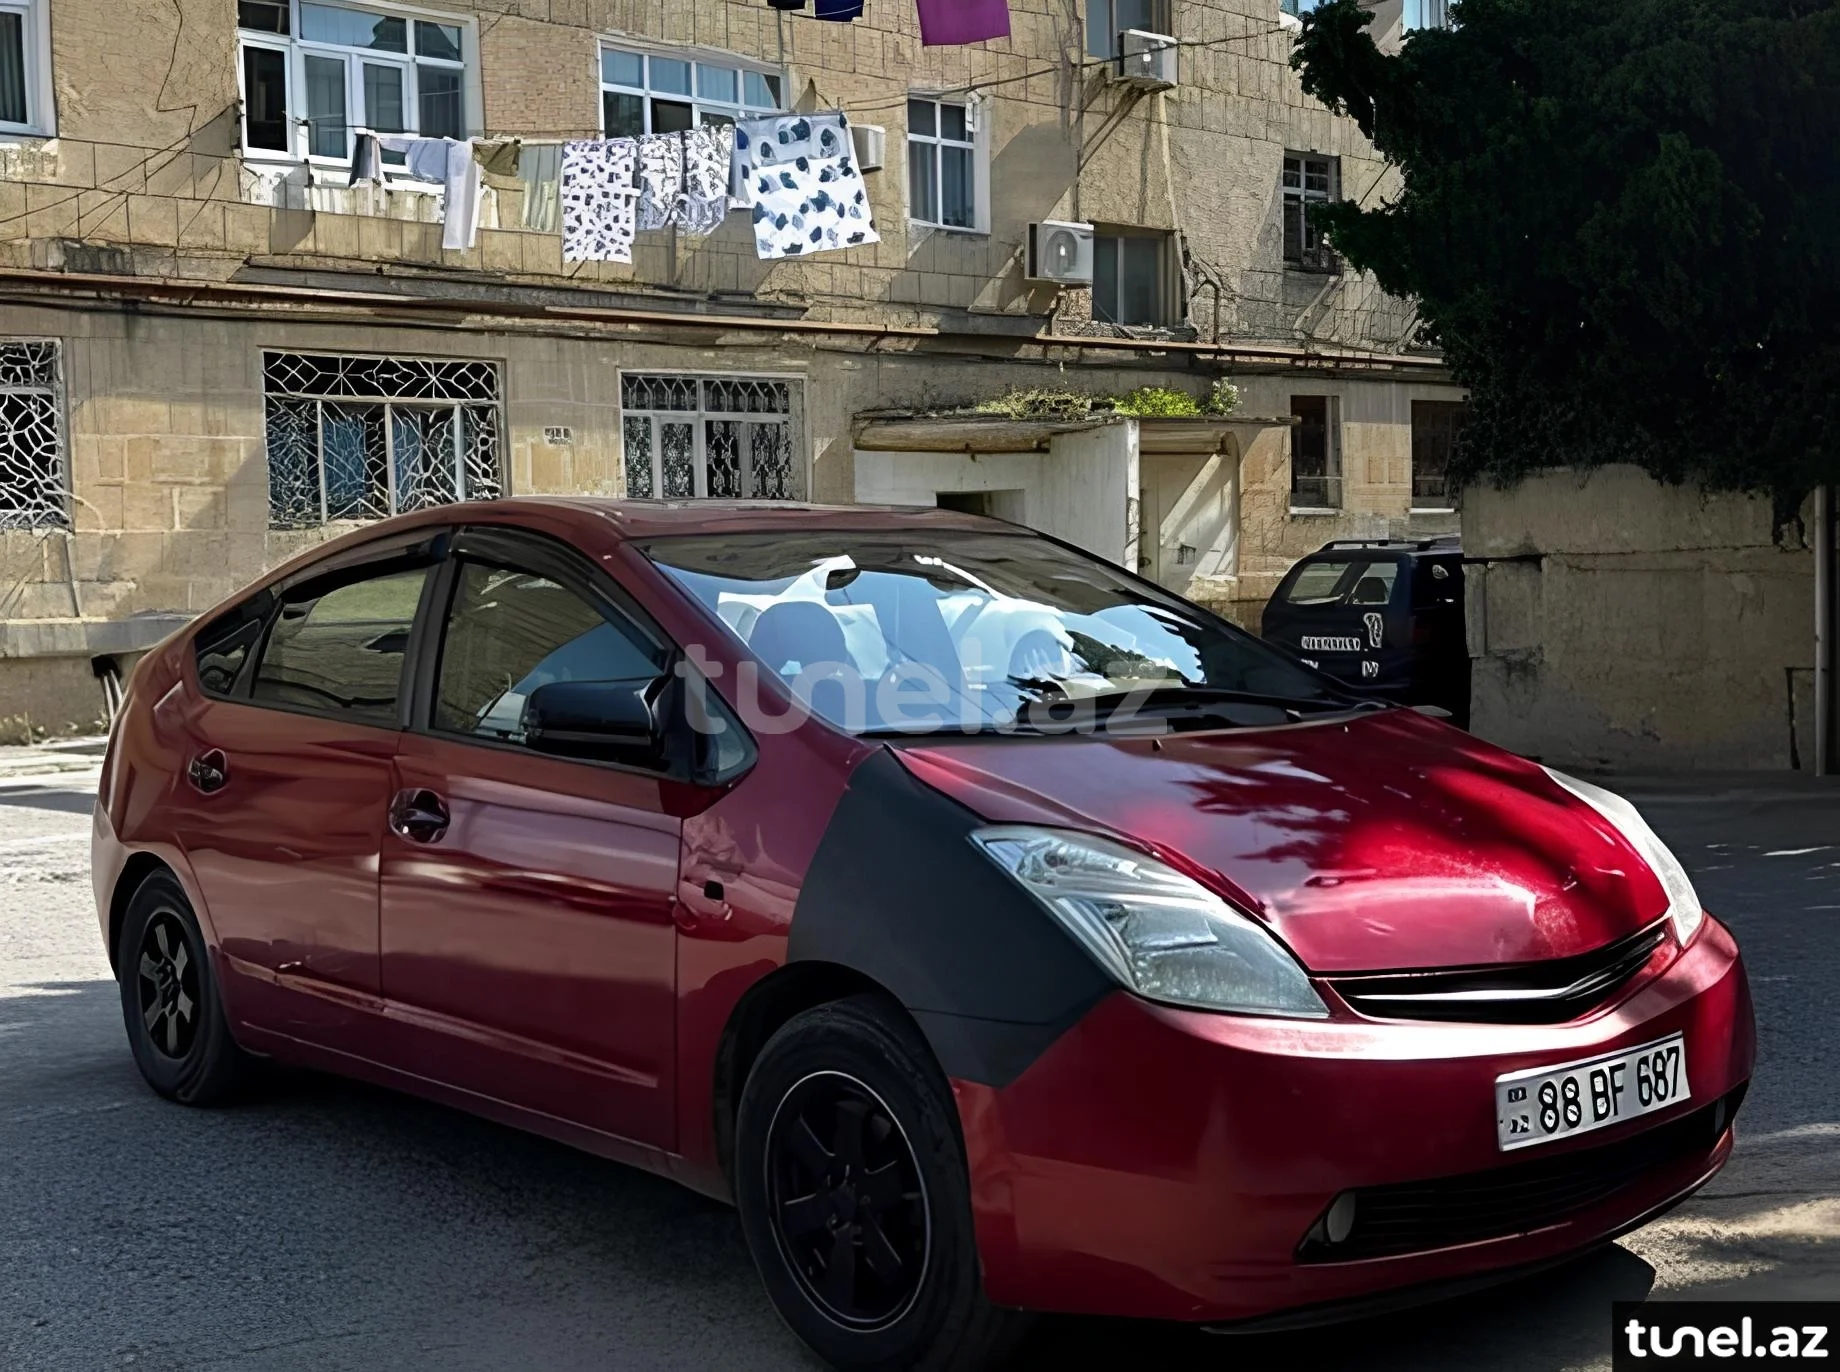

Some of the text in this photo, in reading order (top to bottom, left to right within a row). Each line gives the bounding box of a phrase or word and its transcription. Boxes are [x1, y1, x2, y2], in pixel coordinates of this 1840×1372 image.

[1538, 1046, 1680, 1133] 88 BF 687
